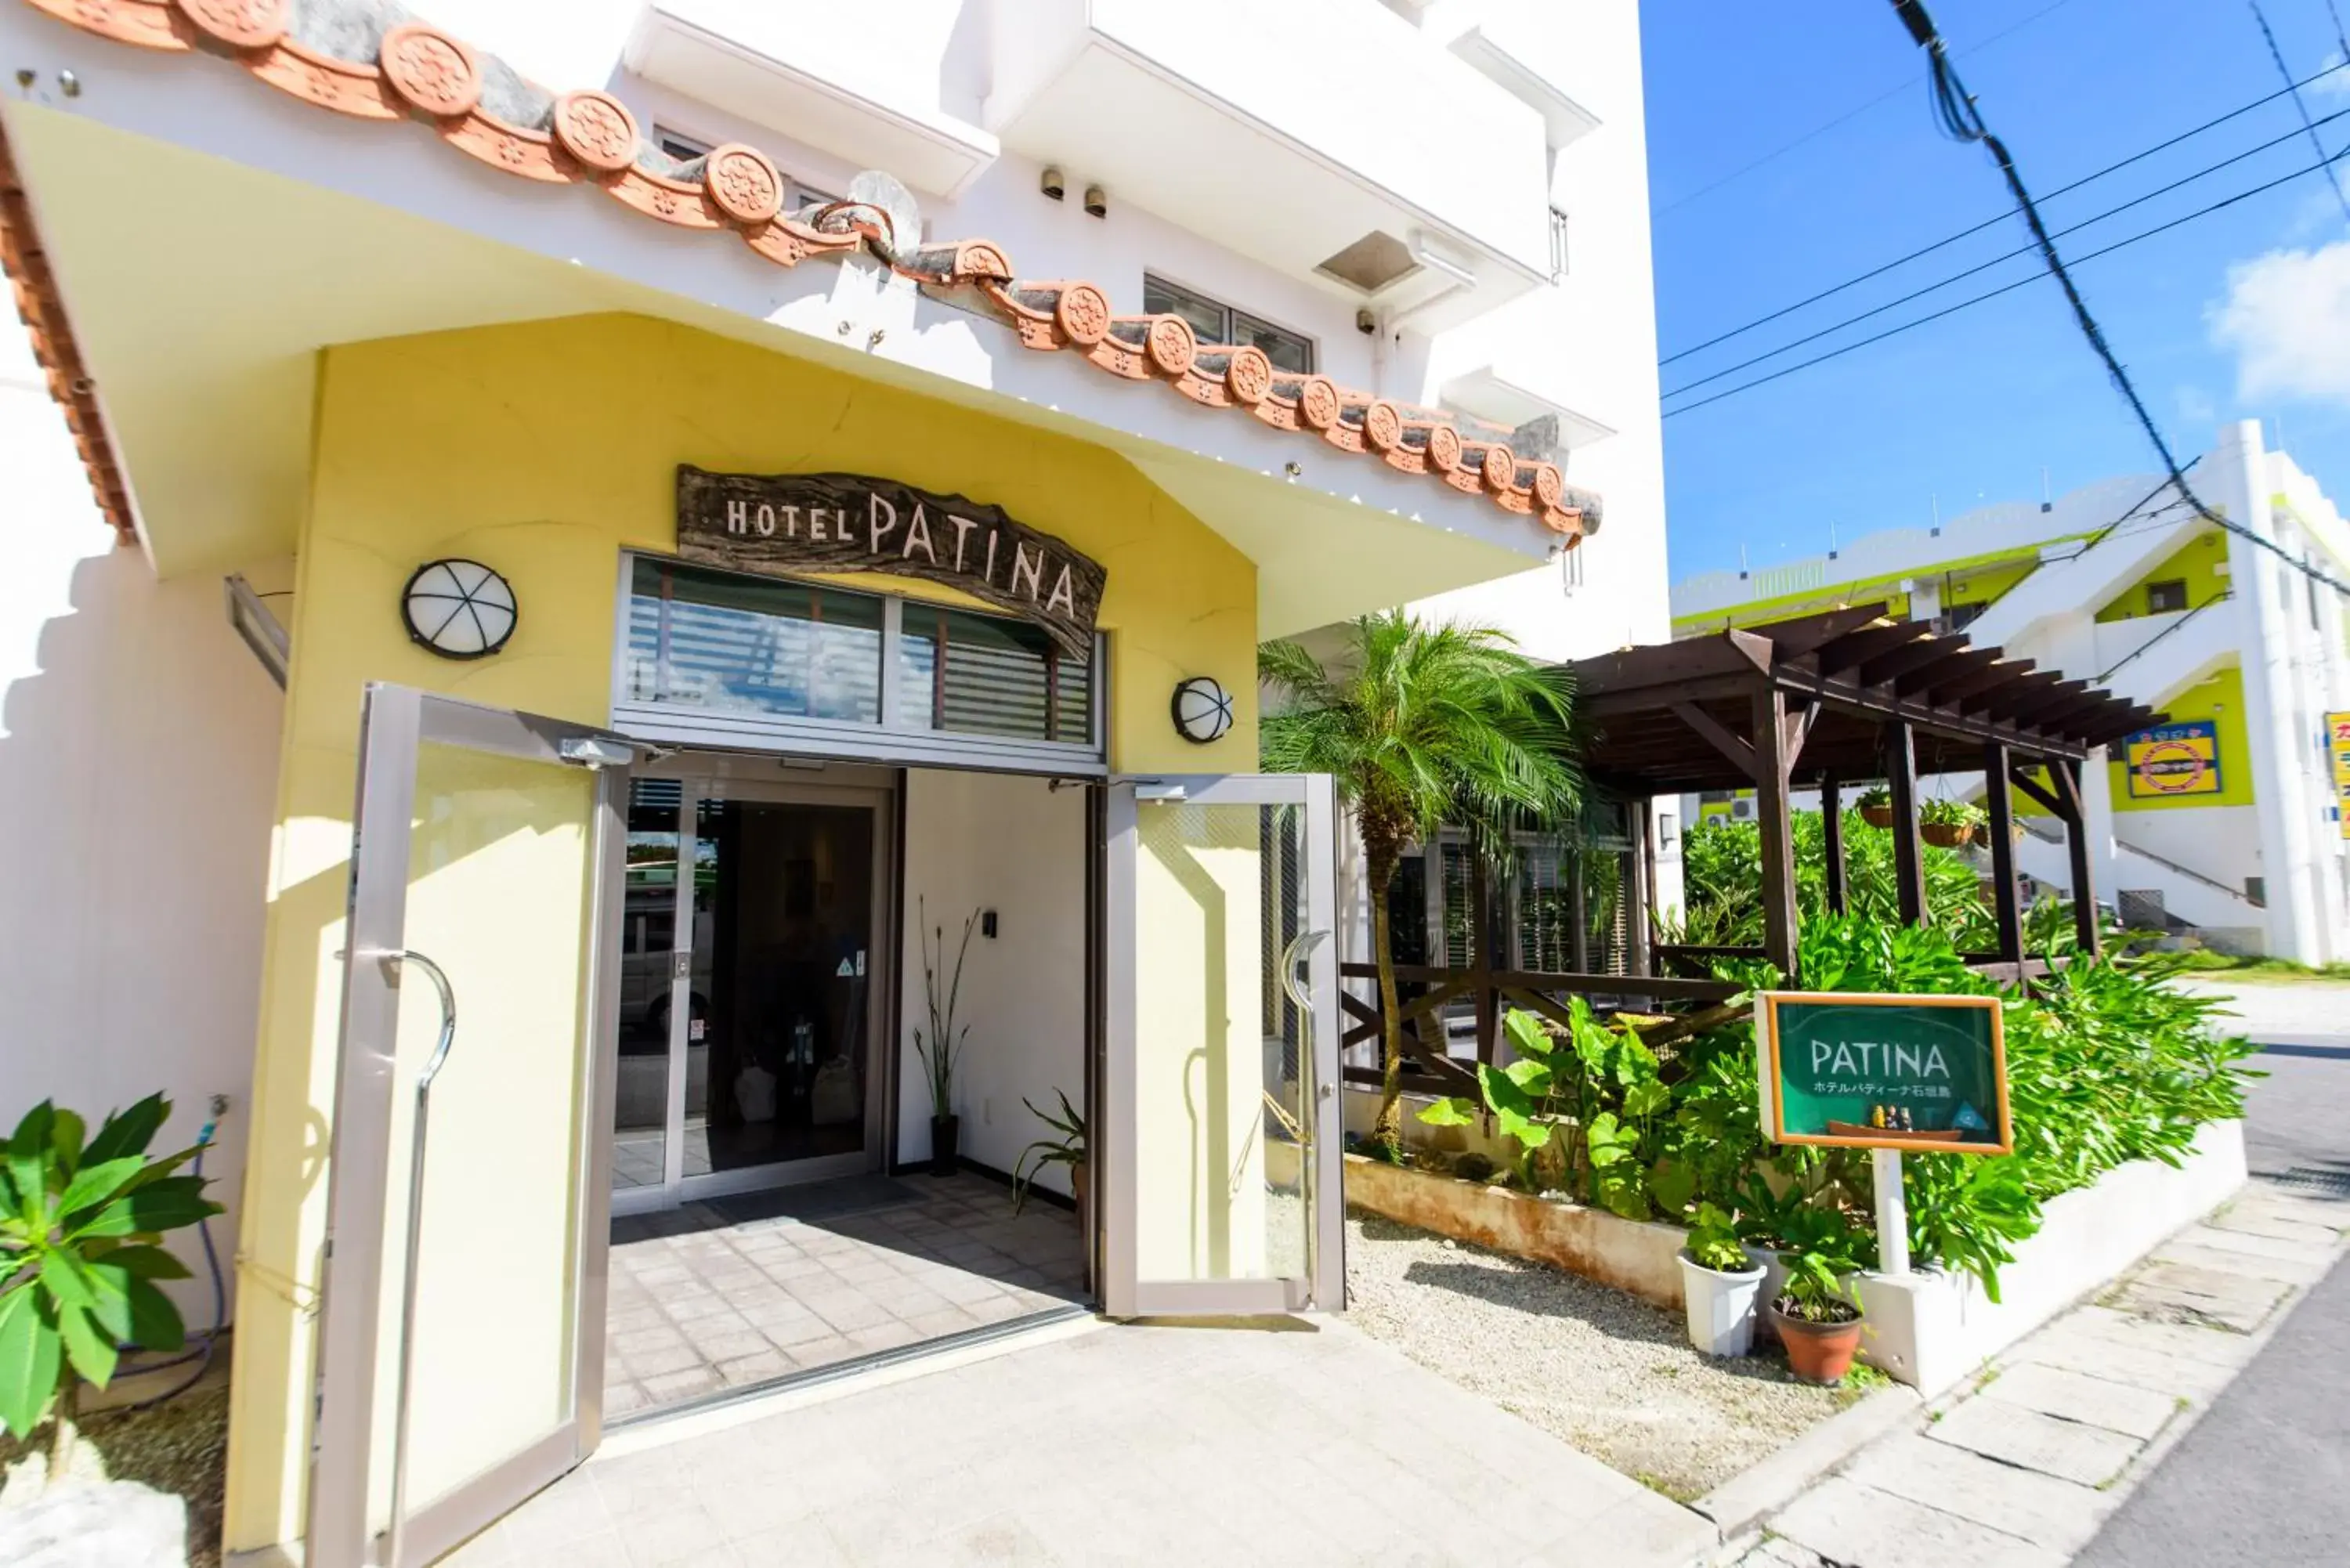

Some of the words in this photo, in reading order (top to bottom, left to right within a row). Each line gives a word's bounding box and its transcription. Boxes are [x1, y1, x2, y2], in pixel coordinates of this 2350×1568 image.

[727, 500, 853, 541] HOTEL
[870, 492, 1075, 619] PATINA
[1811, 1039, 1950, 1078] PATINA
